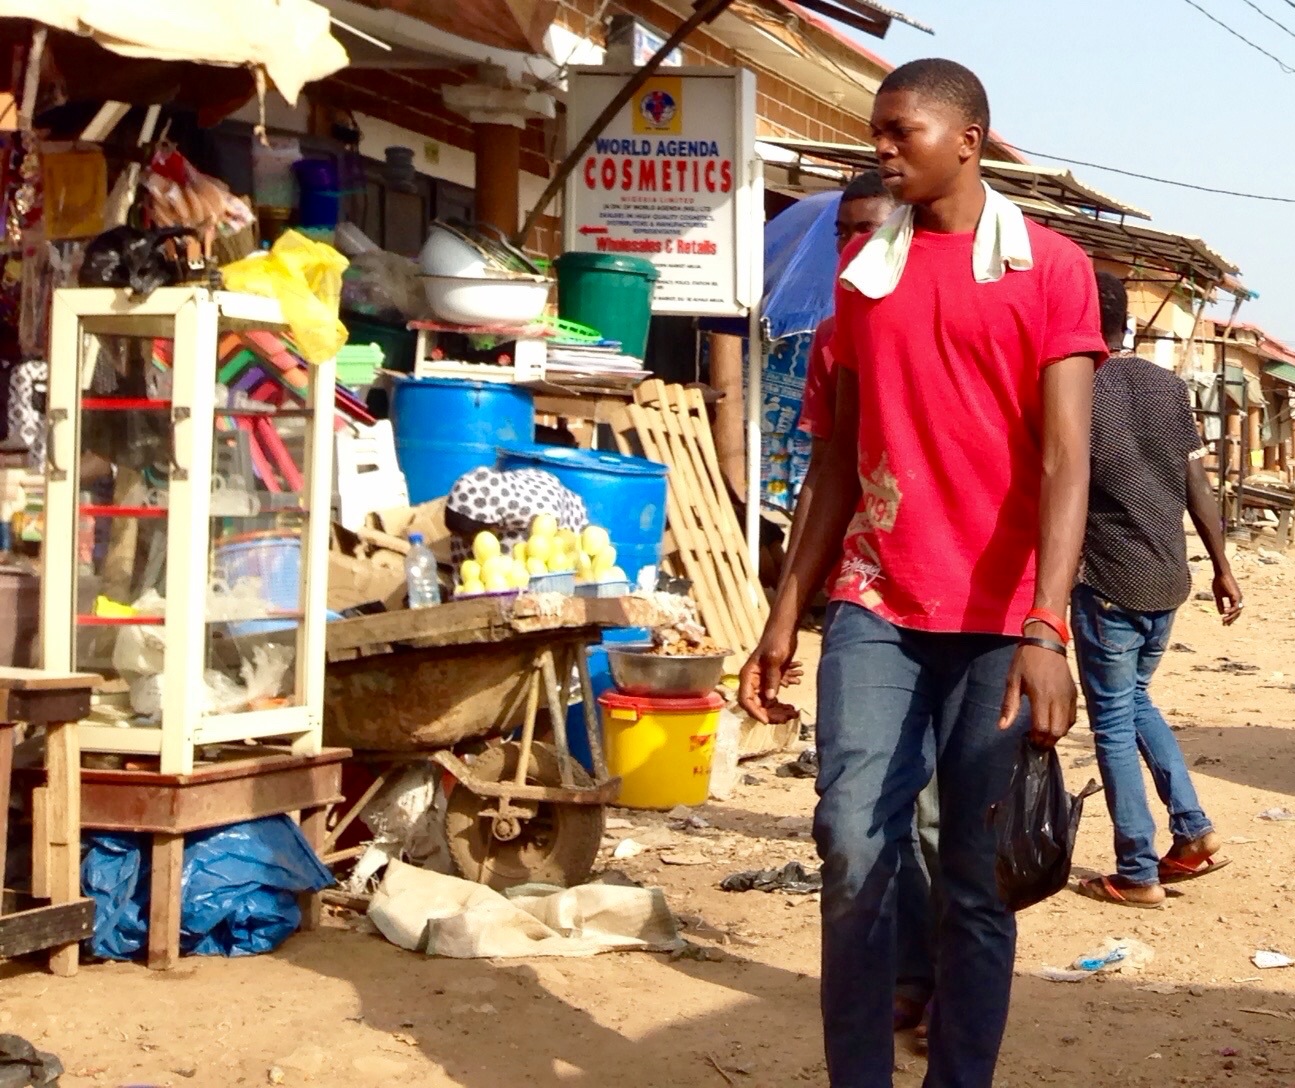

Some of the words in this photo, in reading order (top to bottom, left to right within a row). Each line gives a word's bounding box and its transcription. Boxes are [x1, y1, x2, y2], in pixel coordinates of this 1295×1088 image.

[595, 138, 651, 156] WORLD
[656, 140, 719, 157] AGENDA
[583, 156, 732, 193] COSMETICS
[596, 237, 662, 253] Wholesales
[677, 239, 717, 255] Retails
